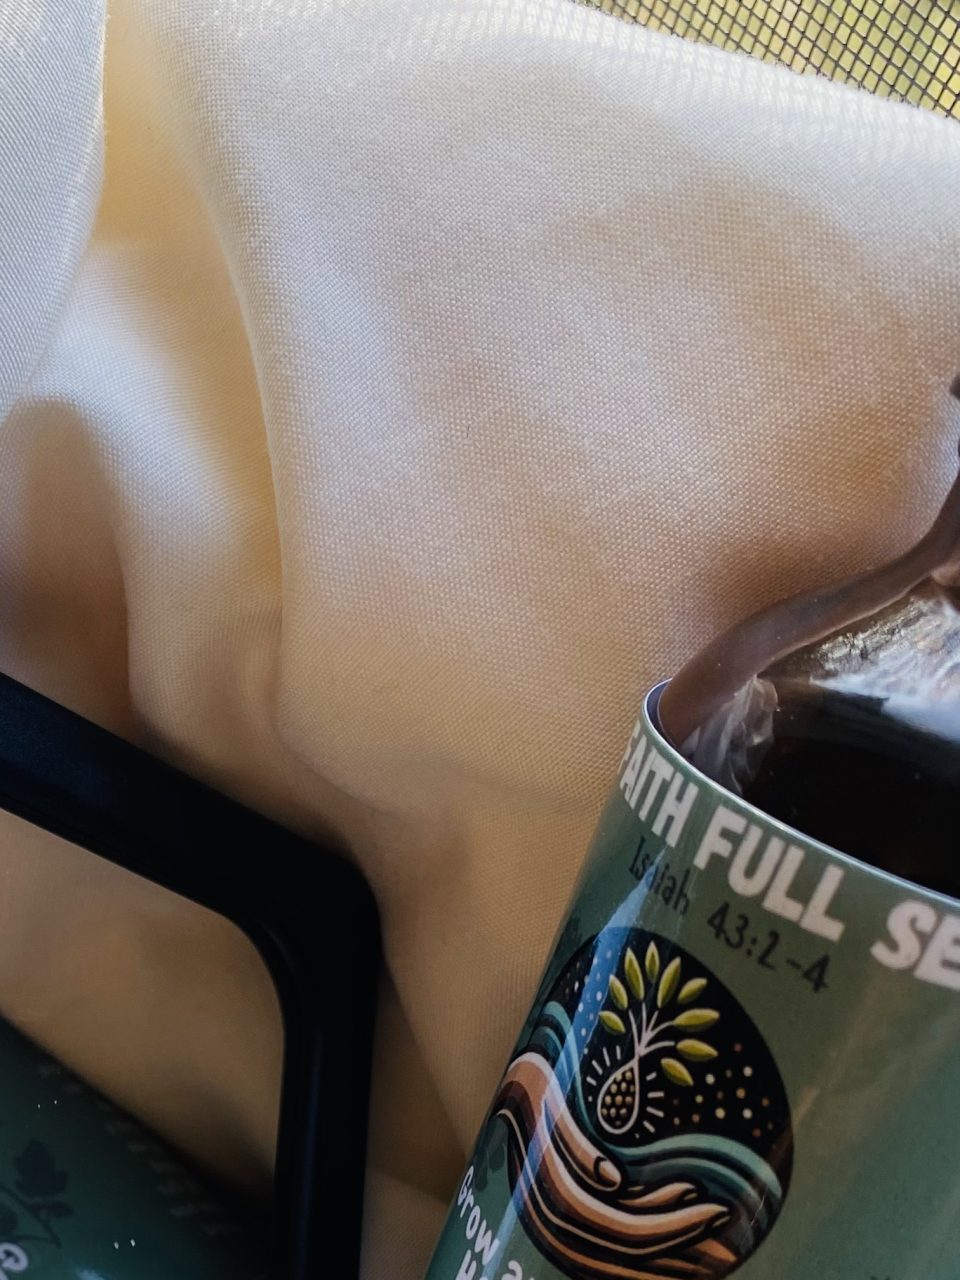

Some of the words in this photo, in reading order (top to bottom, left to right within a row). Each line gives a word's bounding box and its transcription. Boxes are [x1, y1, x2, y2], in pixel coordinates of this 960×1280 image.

[693, 804, 845, 944] FULL
[706, 902, 831, 995] 43:2-4
[457, 1164, 500, 1267] Grow
